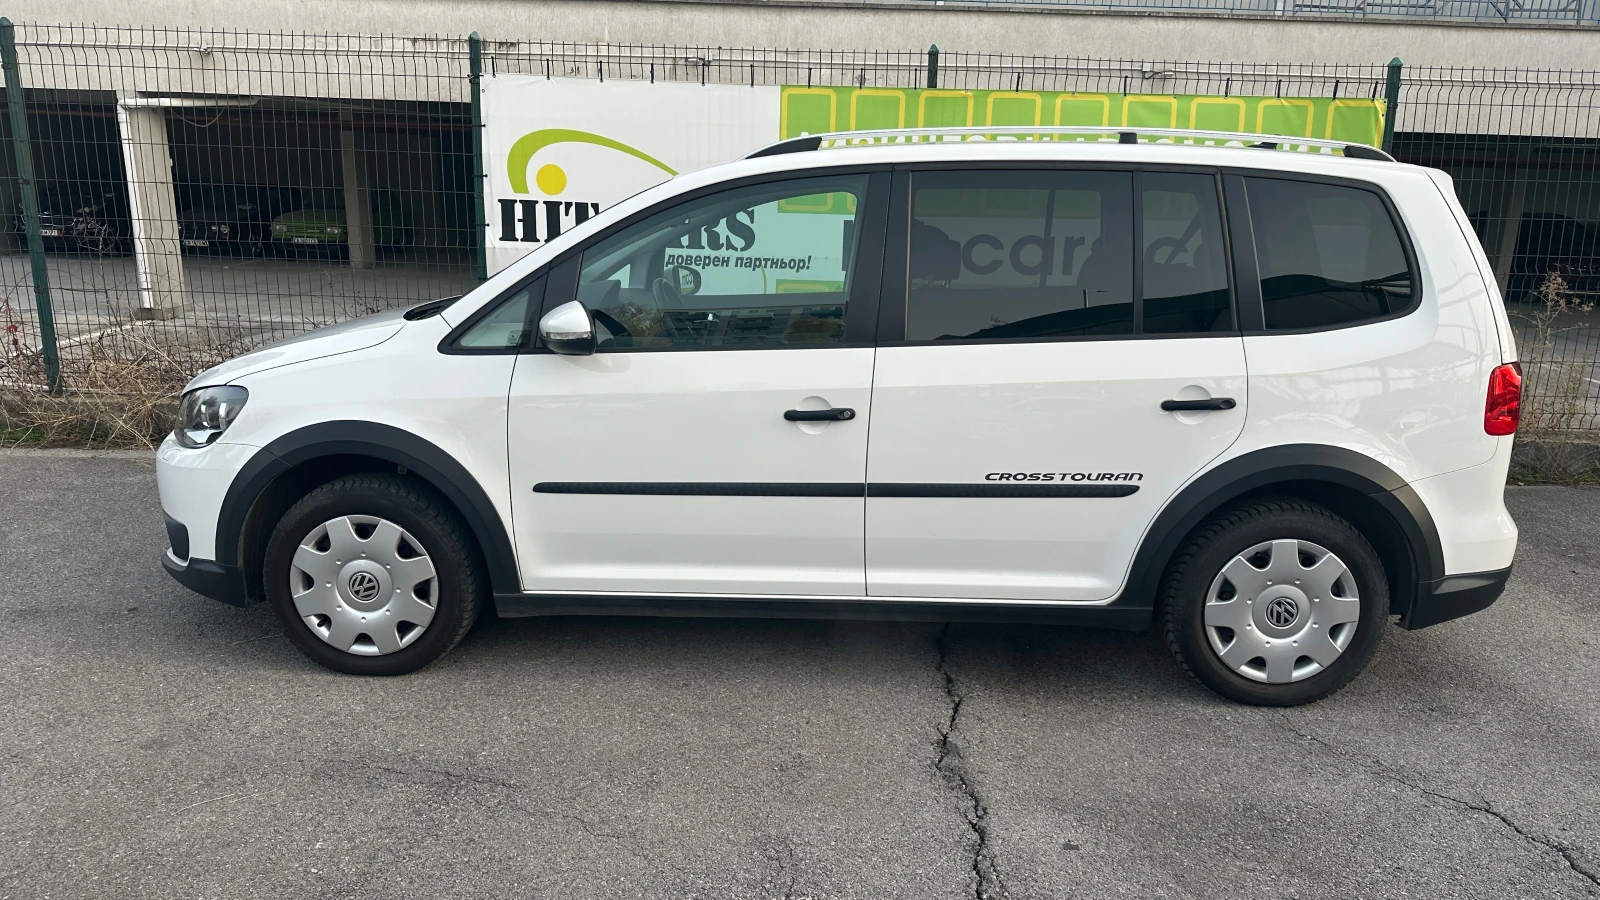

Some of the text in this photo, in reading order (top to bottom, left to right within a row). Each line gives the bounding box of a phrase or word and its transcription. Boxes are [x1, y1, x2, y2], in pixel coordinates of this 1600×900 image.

[665, 254, 812, 272] доверен партньор!
[984, 472, 1144, 481] CROSS TOURAN
